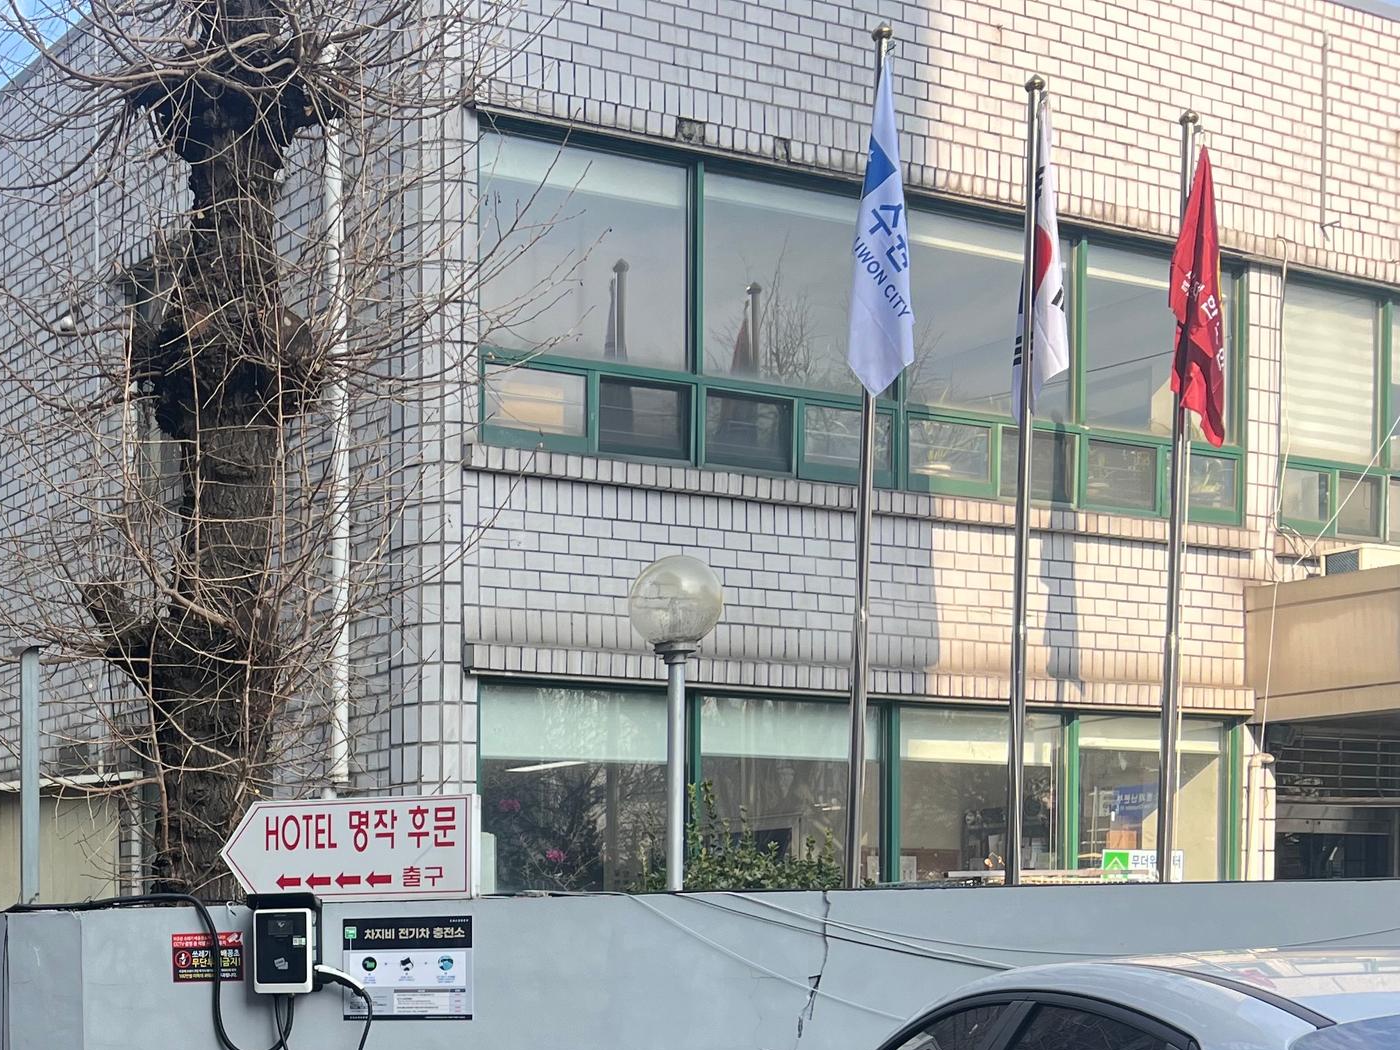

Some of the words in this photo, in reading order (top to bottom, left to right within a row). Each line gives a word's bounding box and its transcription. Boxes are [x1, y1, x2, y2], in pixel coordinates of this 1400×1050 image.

[884, 284, 911, 317] CITY
[265, 814, 337, 851] HOTEL
[349, 809, 397, 852] 명작
[408, 805, 456, 849] 후문
[402, 866, 443, 887] 출구
[364, 928, 395, 940] 차지비
[398, 927, 430, 939] 전기차
[433, 927, 465, 939] 충전소
[192, 950, 211, 958] 쓰레기
